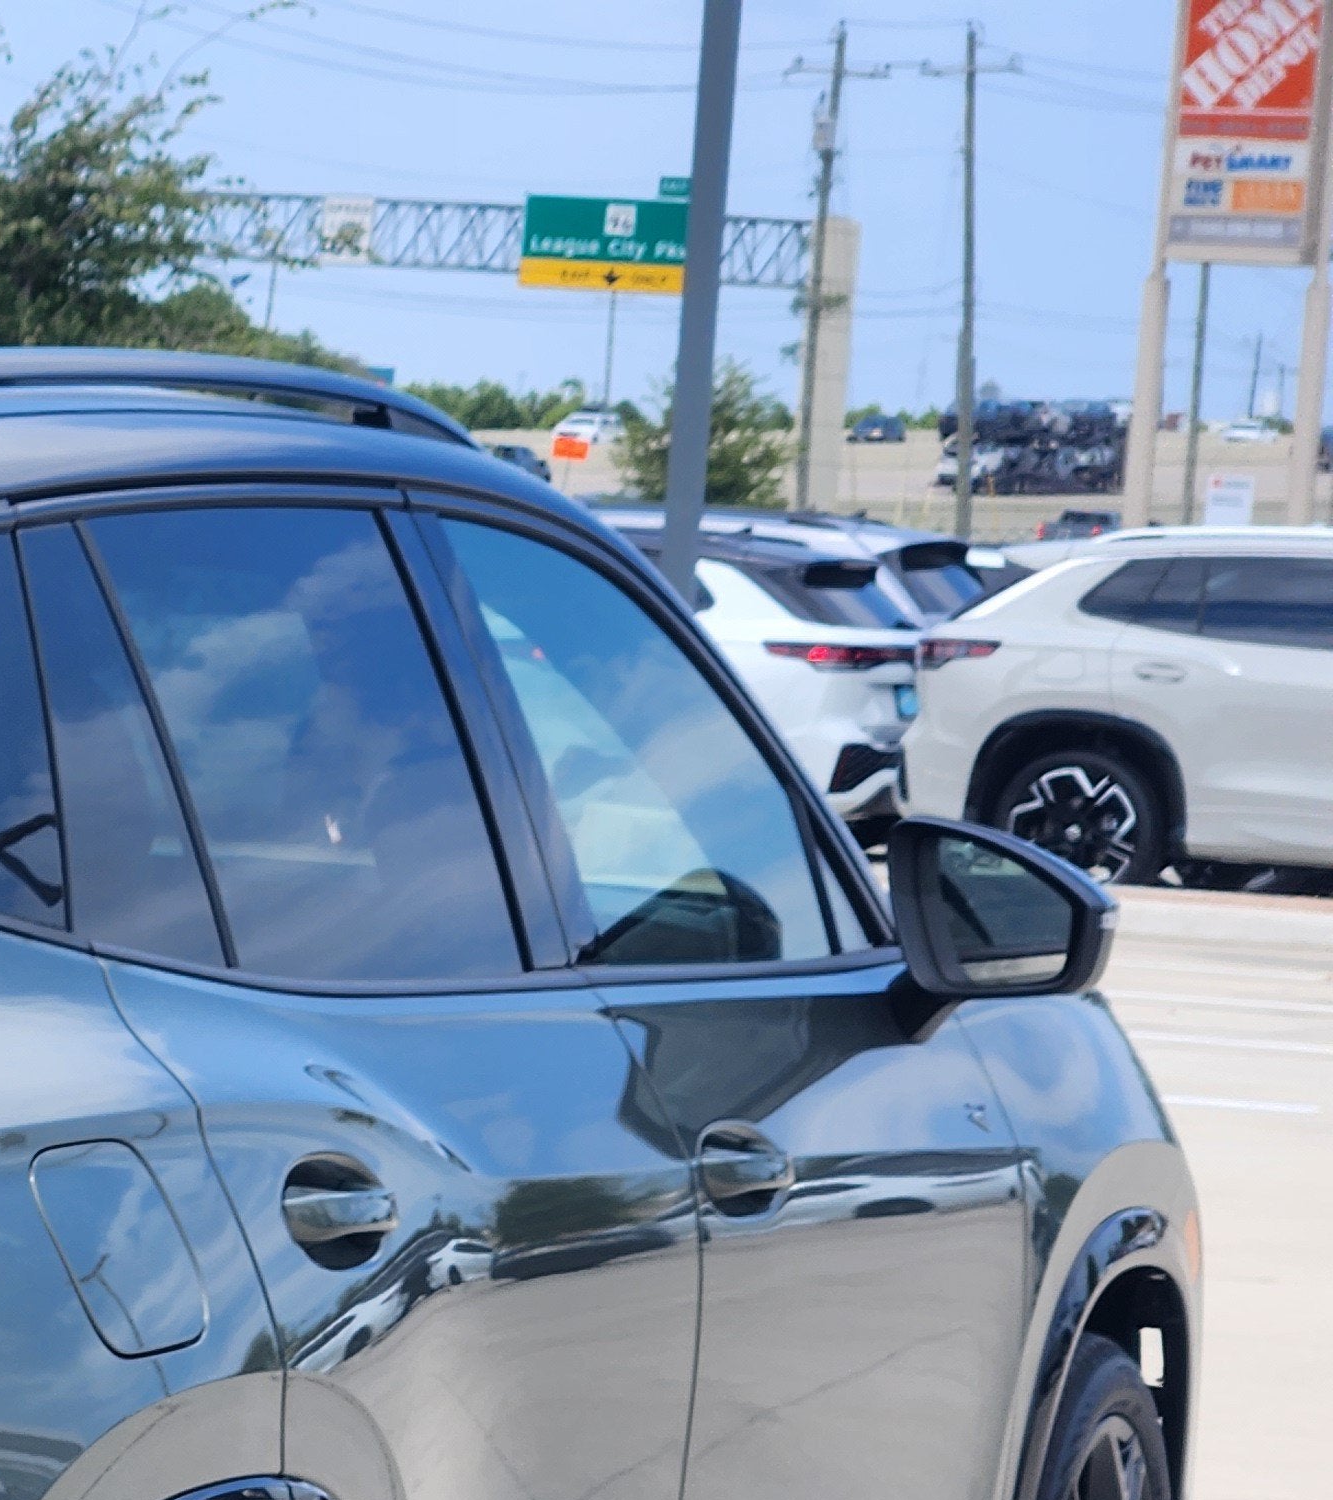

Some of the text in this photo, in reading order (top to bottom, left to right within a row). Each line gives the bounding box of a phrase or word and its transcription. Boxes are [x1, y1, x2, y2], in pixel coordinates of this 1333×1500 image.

[1234, 25, 1321, 110] DEPOT
[530, 234, 601, 258] League
[607, 237, 647, 260] City
